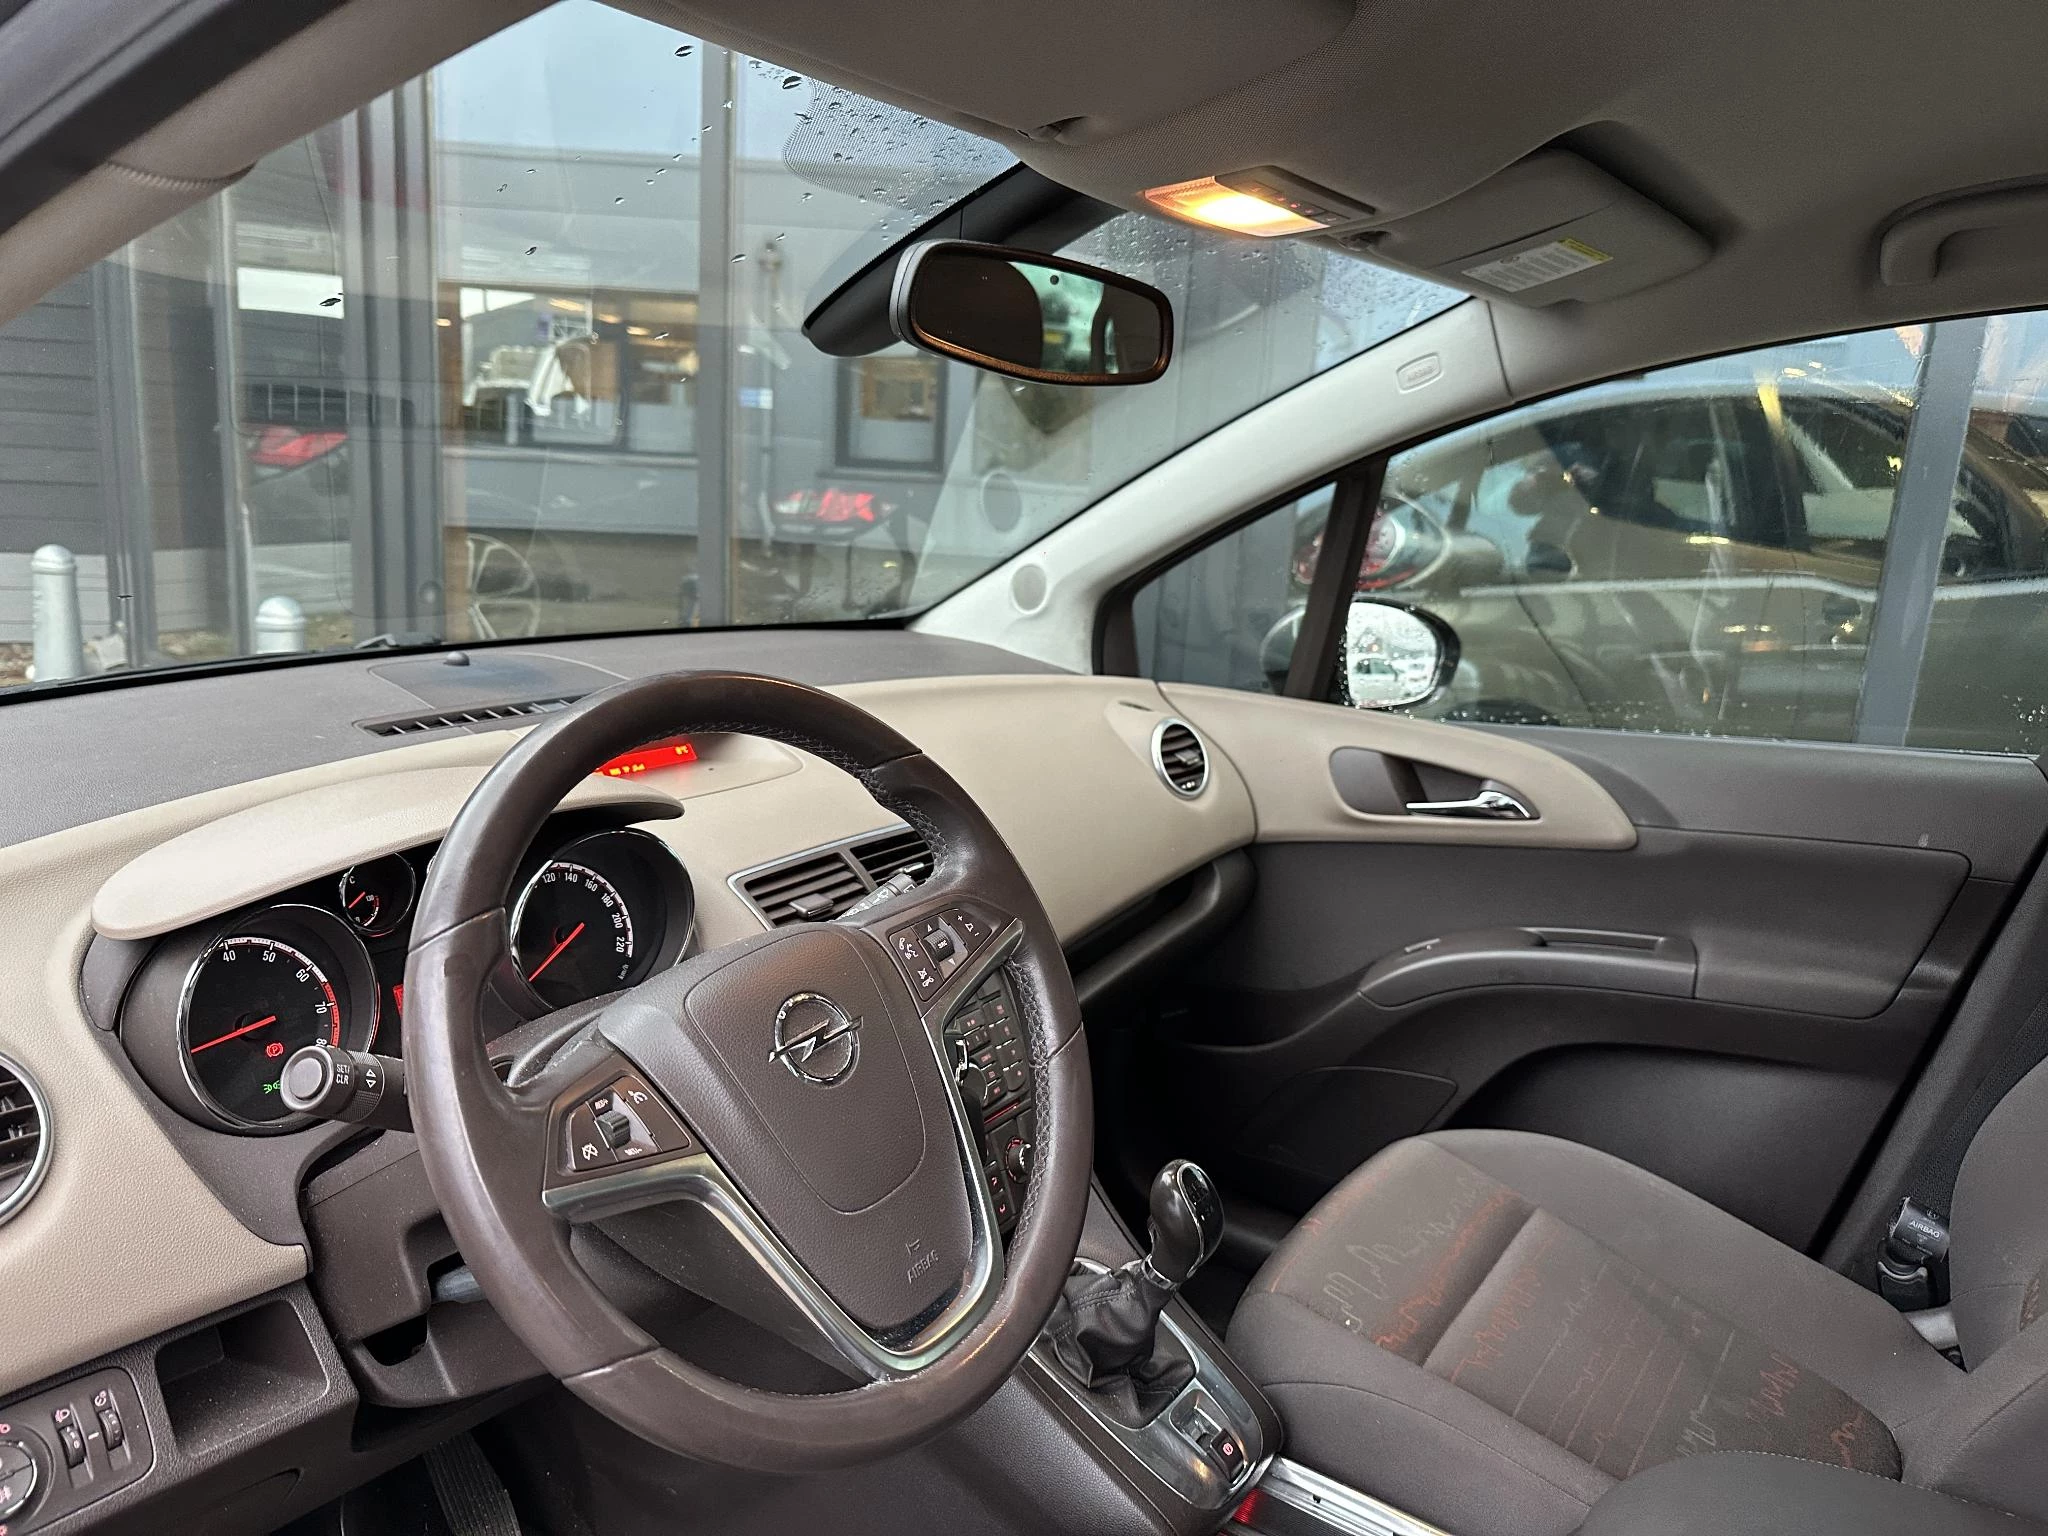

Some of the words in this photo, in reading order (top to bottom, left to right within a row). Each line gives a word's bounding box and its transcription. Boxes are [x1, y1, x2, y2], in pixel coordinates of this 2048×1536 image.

[542, 872, 556, 884] 120
[564, 872, 578, 883] 140
[585, 879, 598, 892] 160
[601, 893, 613, 908] 180
[612, 913, 623, 929] 200
[616, 936, 625, 953] 220
[222, 950, 236, 963] 40
[262, 950, 276, 963] 50
[295, 968, 310, 983] 60
[314, 1001, 327, 1015] 70
[315, 1037, 328, 1048] 8
[336, 1073, 349, 1086] CLR
[1909, 1220, 1940, 1238] AIRBAG
[907, 1249, 939, 1285] AIRBAG
